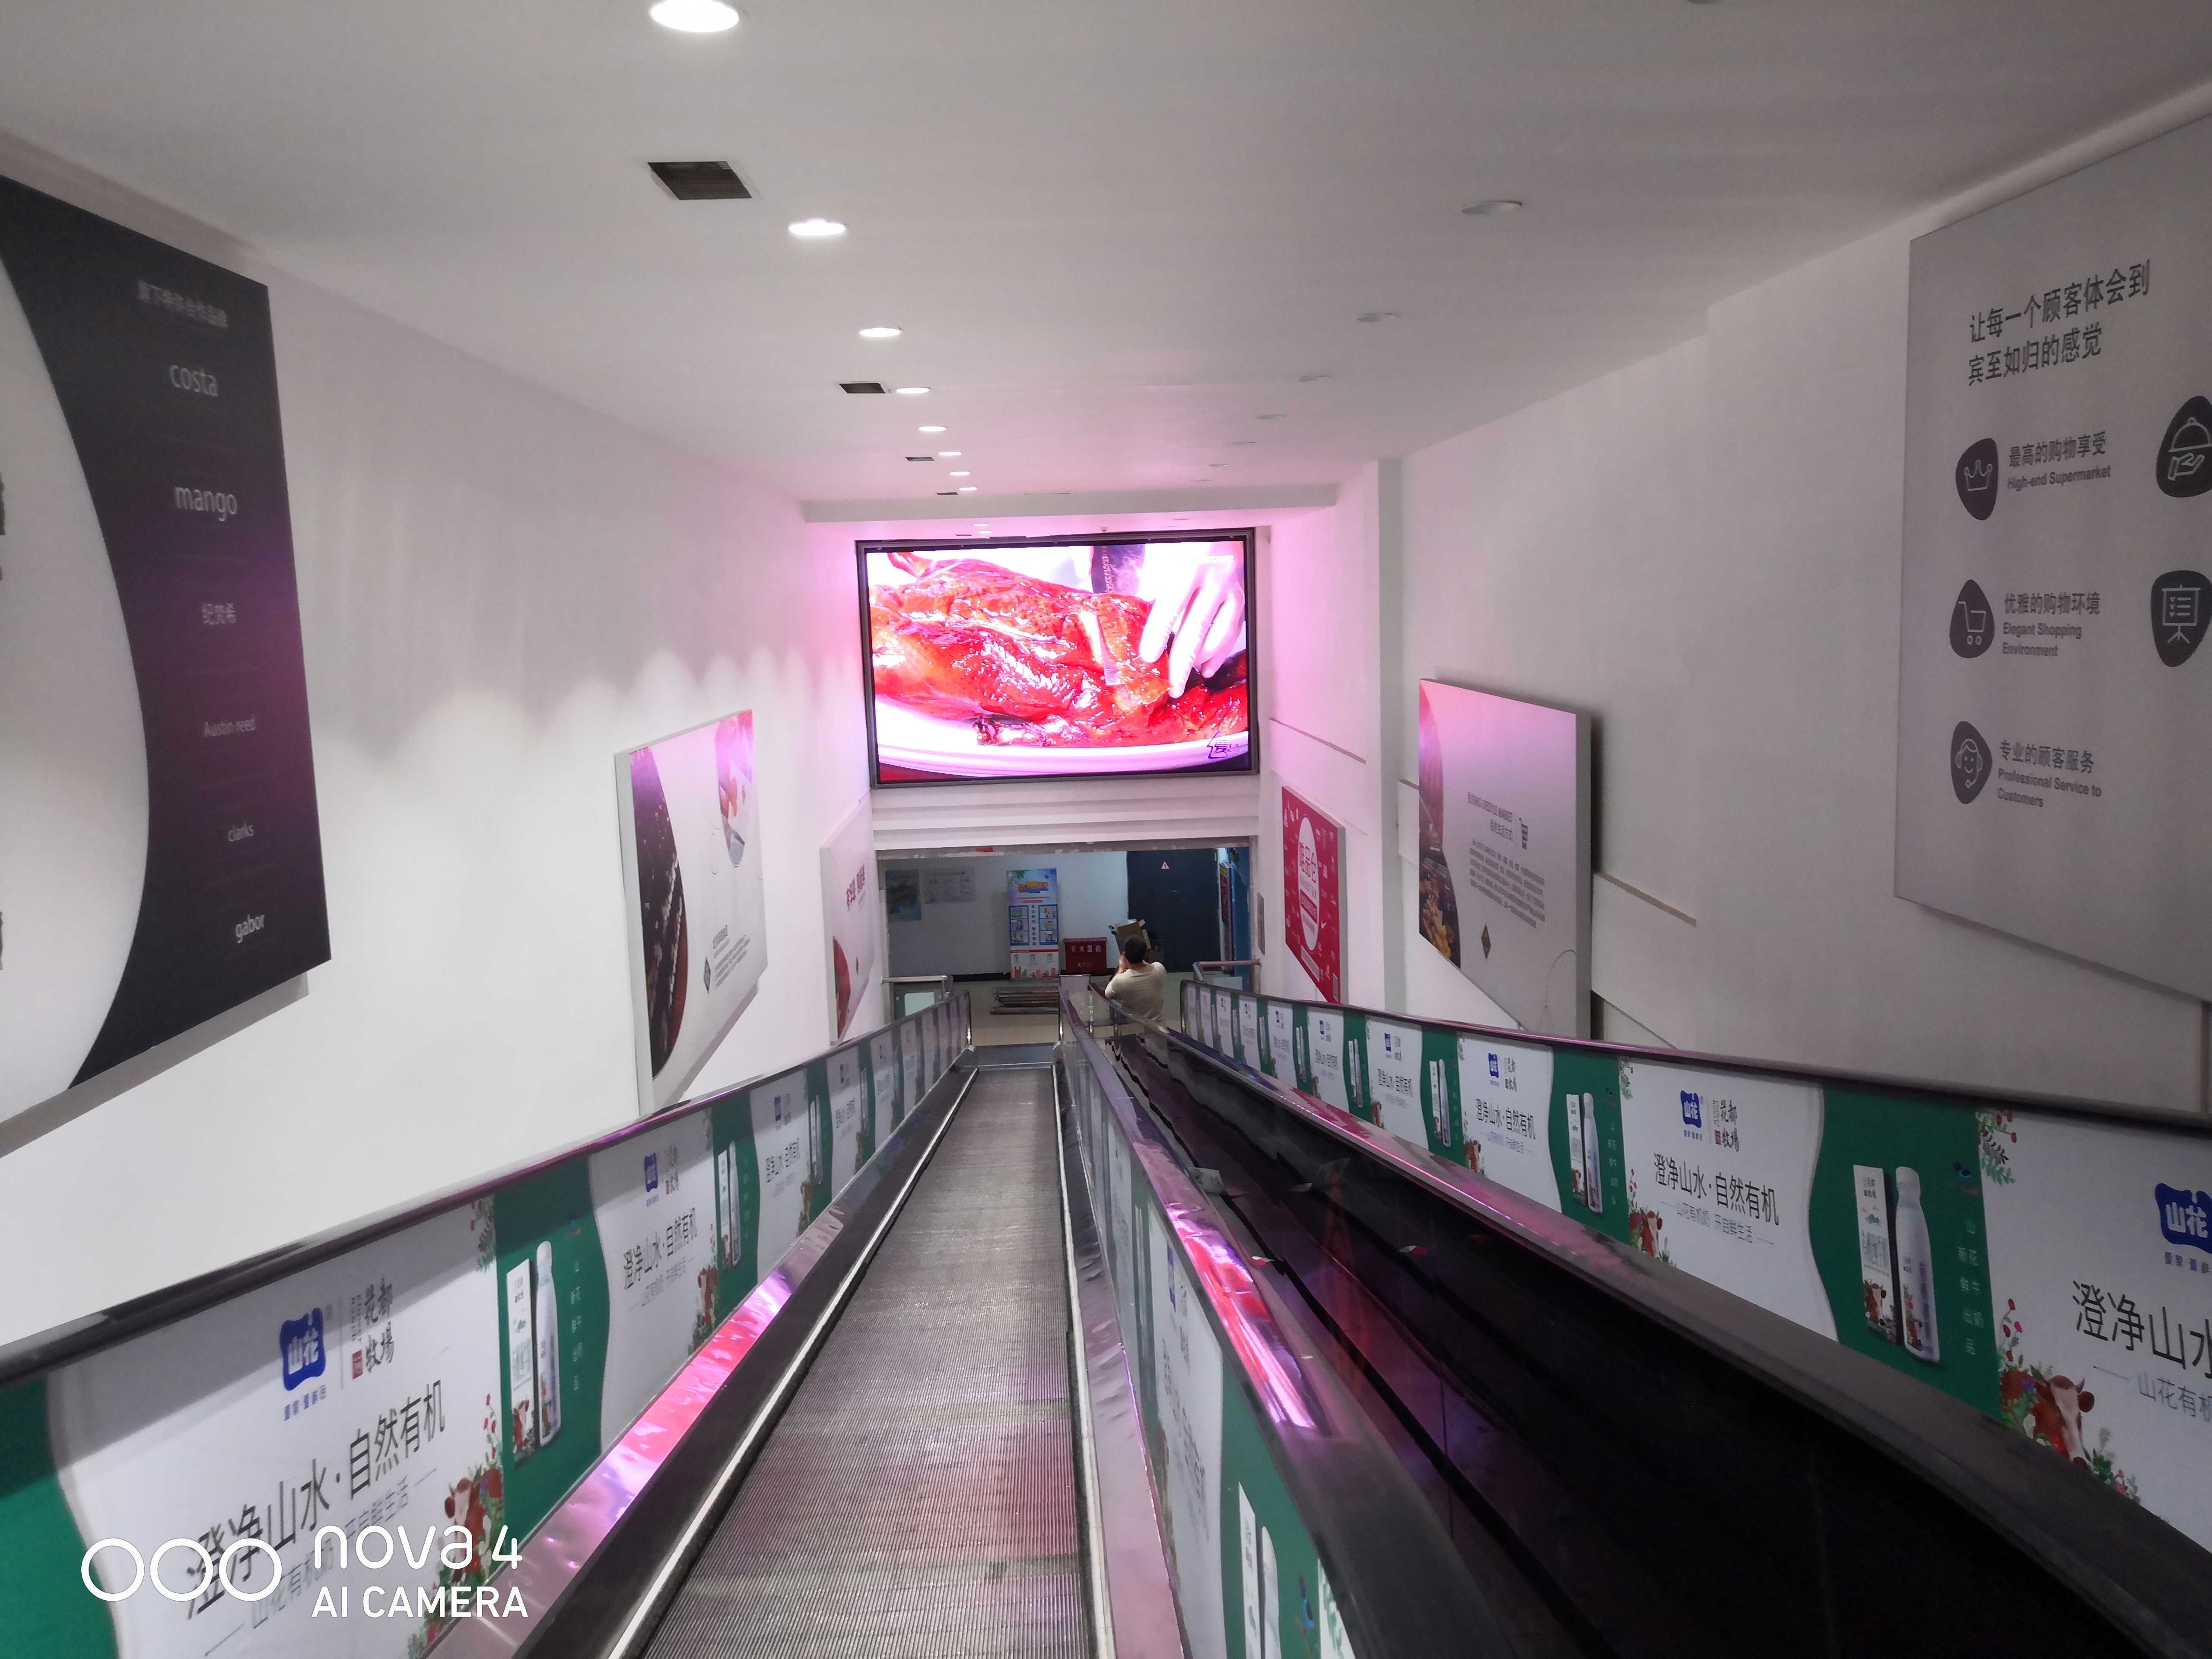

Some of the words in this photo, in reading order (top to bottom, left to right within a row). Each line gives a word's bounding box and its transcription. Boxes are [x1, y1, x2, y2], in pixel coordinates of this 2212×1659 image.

[1969, 259, 2150, 343] 让每一个顾客体会到
[1968, 321, 2103, 386] 宾至如归的感觉
[169, 364, 218, 397] costa
[2009, 431, 2106, 468] 最高的购物享受
[2007, 473, 2047, 492] High-end
[2049, 465, 2111, 486] Supermarket
[175, 486, 238, 522] mango
[2004, 591, 2101, 615] 优雅的购物环境
[2002, 622, 2035, 638] Elegant
[2037, 623, 2082, 639] Shopping
[2002, 642, 2058, 657] Environment
[204, 719, 234, 737] Austin
[1999, 739, 2094, 774] 专业的顾客服务
[1997, 788, 2044, 808] Customers
[1998, 767, 2052, 789] Professional
[2054, 778, 2090, 795] Service
[2091, 785, 2102, 797] to
[228, 823, 254, 842] clarks
[235, 912, 265, 944] gabor
[2165, 1201, 2209, 1239] 山花
[288, 1326, 320, 1375] 山花
